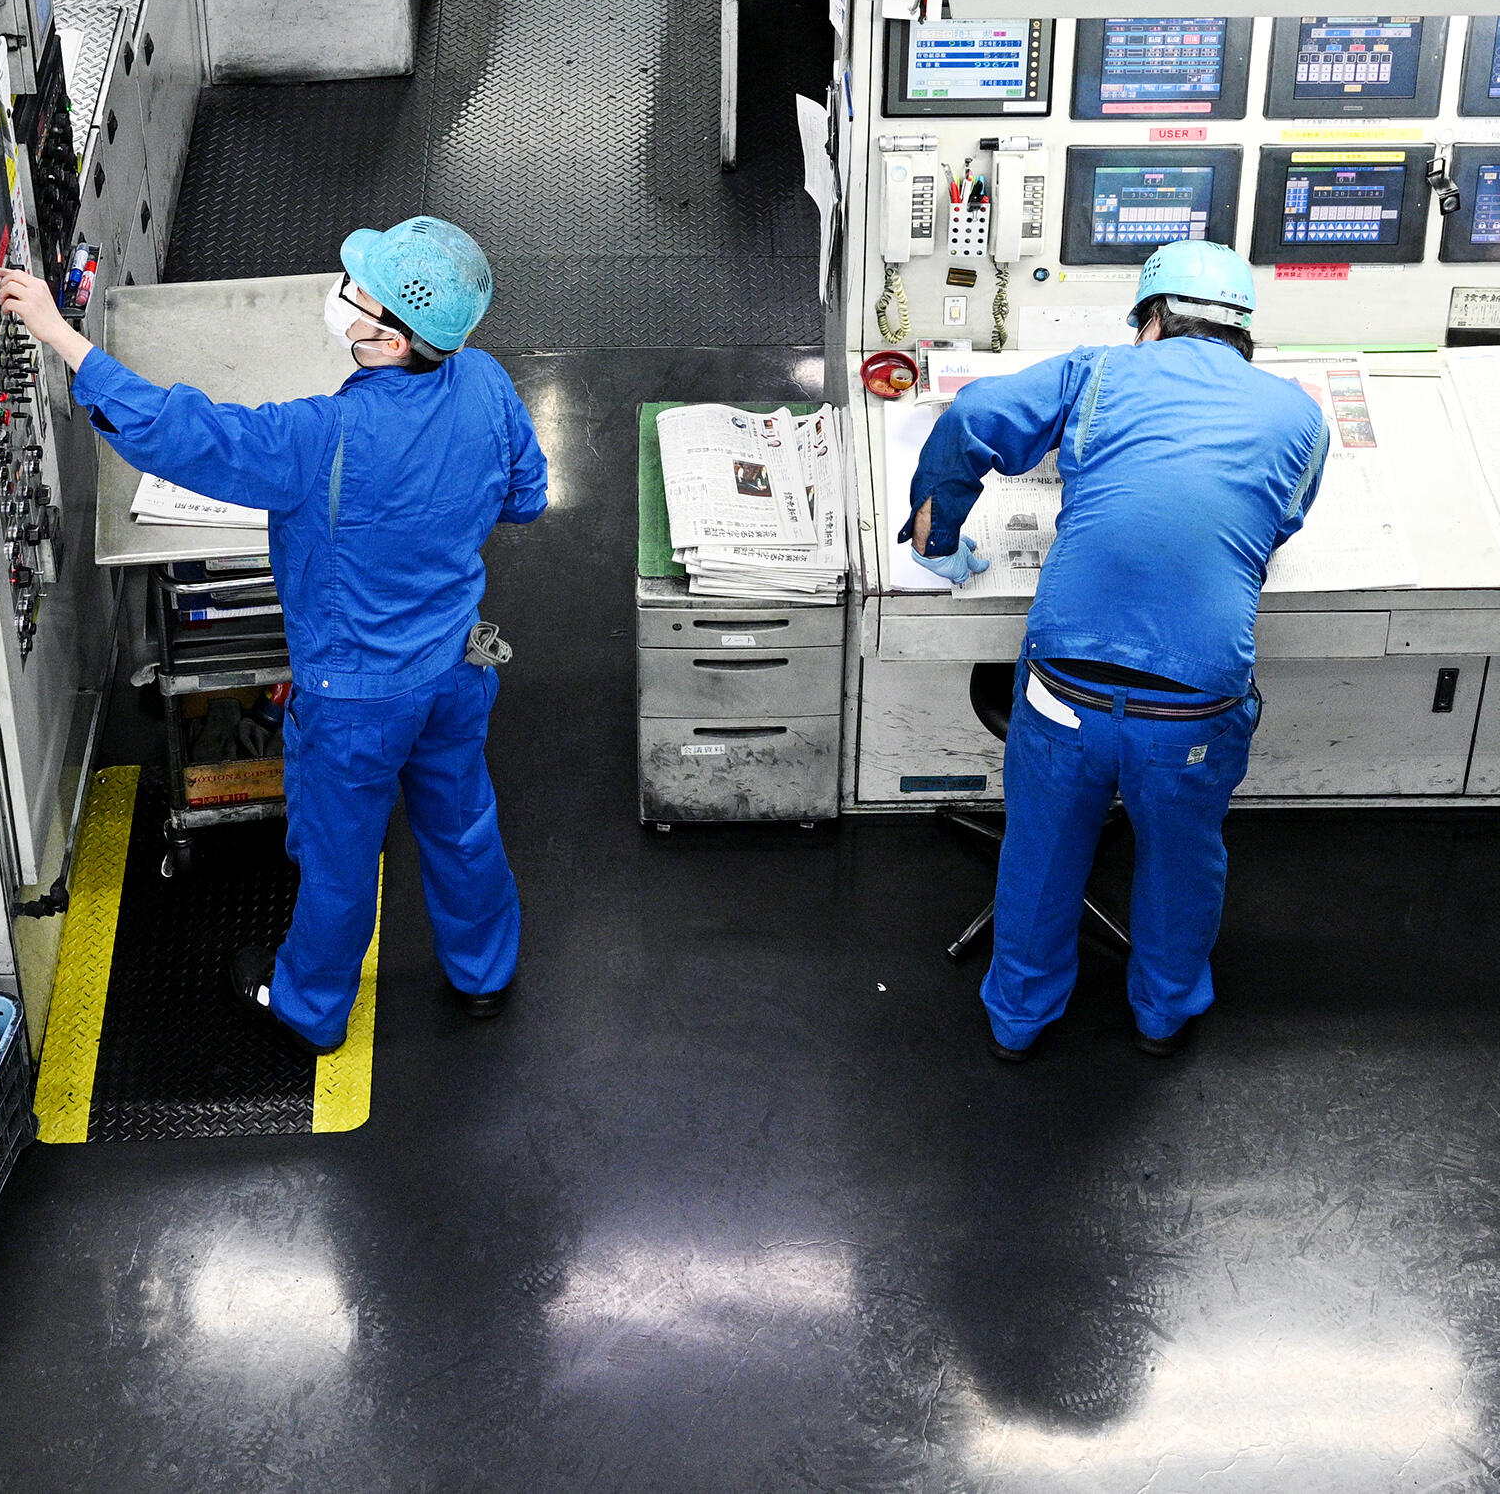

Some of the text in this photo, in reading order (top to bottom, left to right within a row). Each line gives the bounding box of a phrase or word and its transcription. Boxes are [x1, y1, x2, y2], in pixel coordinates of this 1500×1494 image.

[1158, 129, 1204, 138] USER 1
[724, 637, 754, 645] ノート
